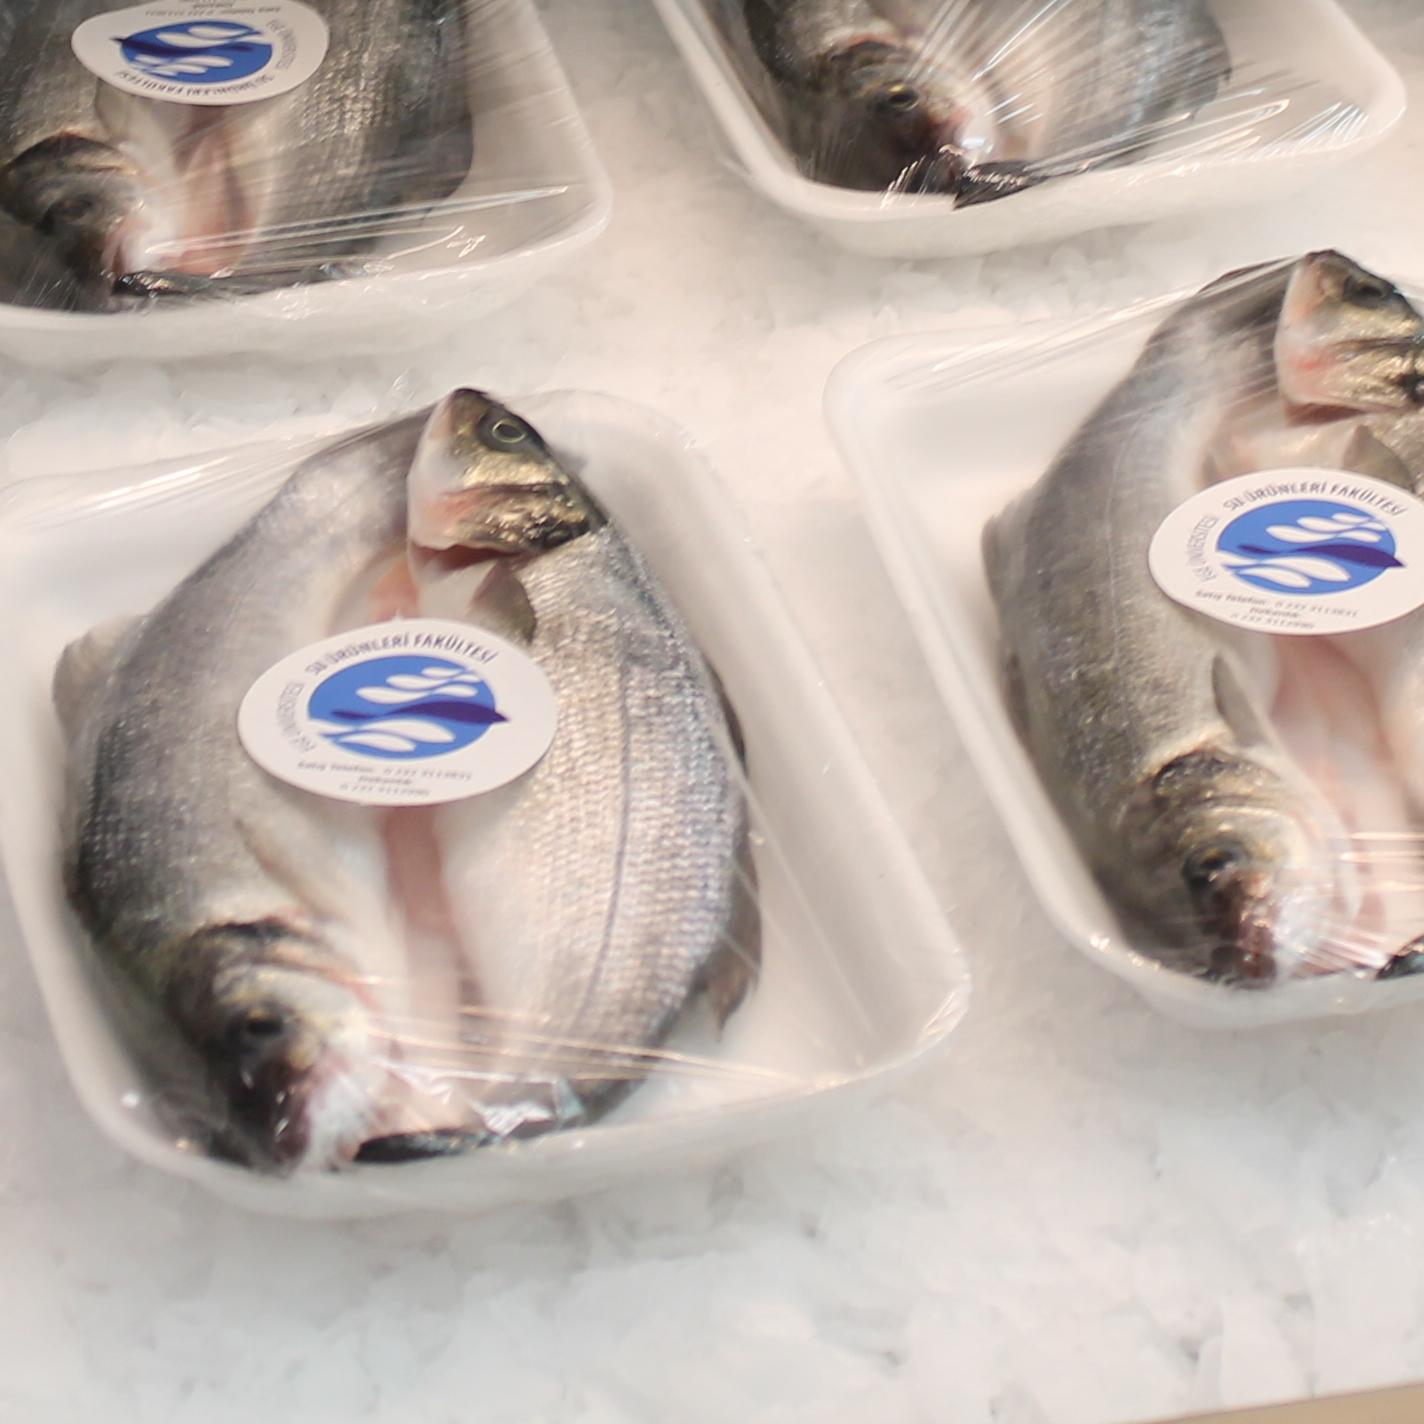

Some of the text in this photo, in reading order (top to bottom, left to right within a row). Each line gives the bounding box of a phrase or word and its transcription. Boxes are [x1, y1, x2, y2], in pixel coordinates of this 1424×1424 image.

[1244, 480, 1328, 505] ÜRÜNLERİ
[1330, 482, 1410, 516] FAKÜLTESİ
[328, 632, 411, 665] ÜRÜNLERİ
[413, 632, 499, 664] FAKÜLTESİ
